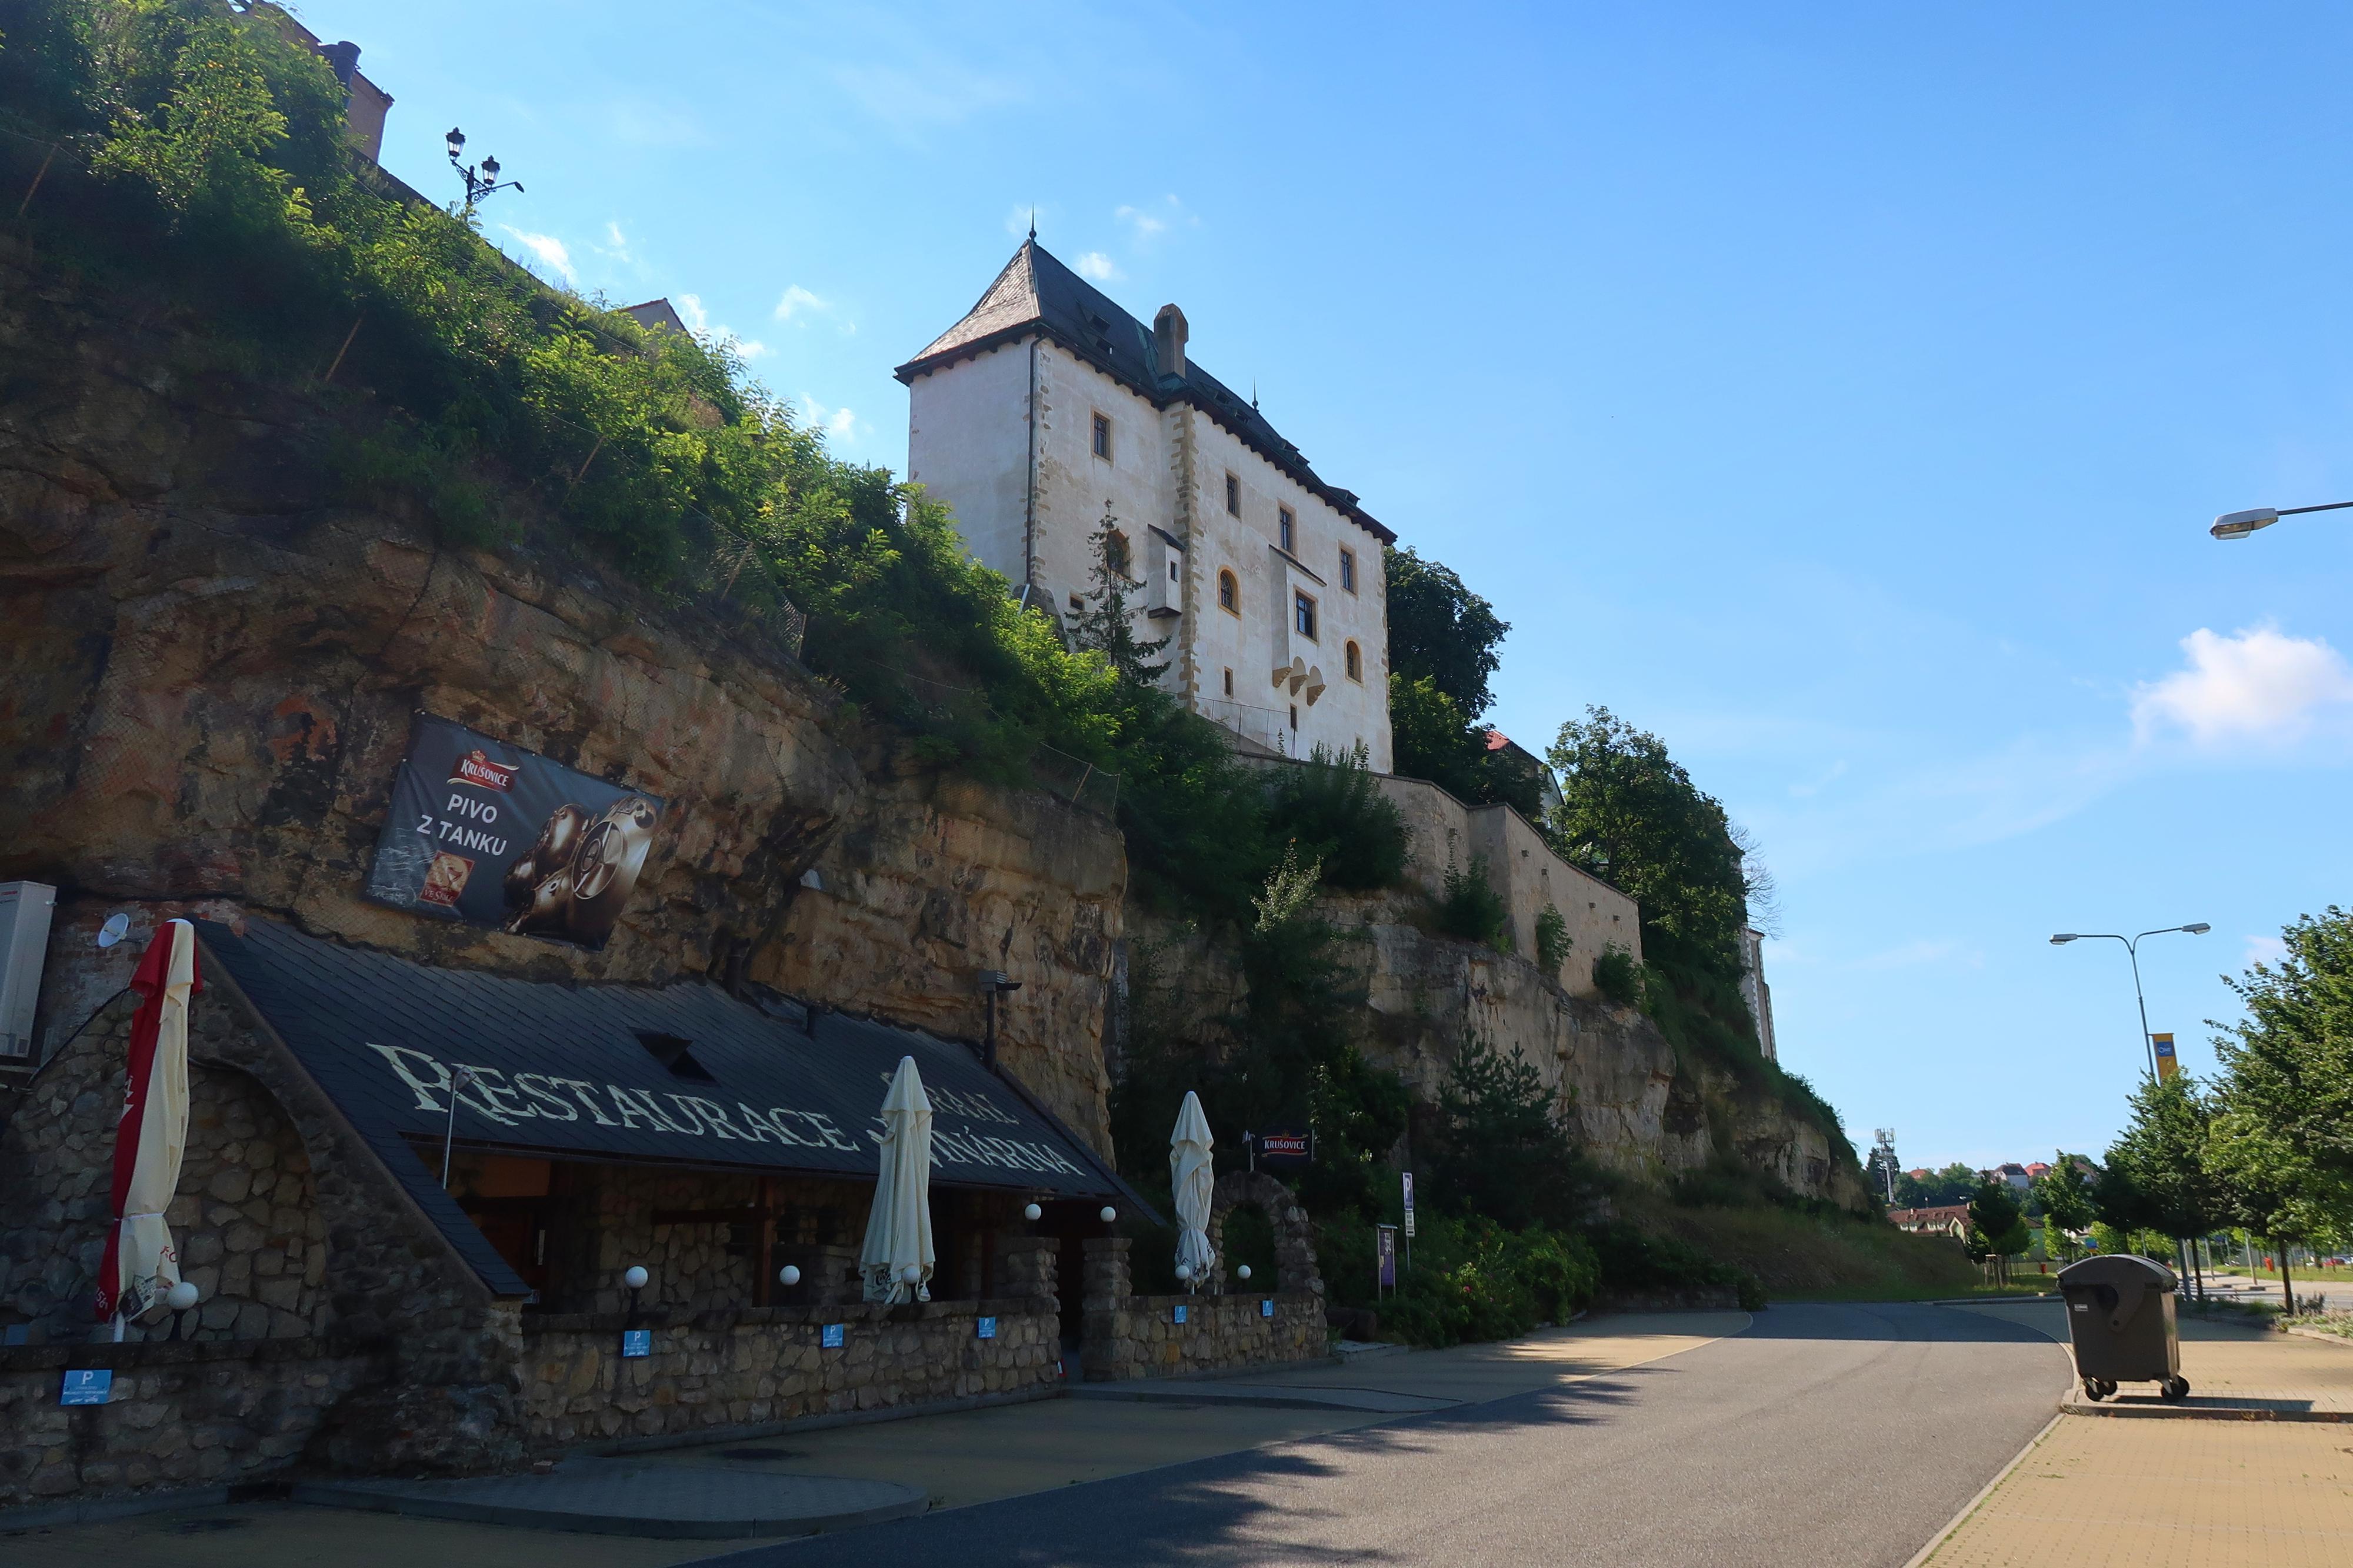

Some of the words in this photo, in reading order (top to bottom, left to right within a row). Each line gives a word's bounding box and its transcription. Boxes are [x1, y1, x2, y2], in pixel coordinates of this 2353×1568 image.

[461, 759, 509, 786] KRUŠOVICE
[447, 793, 498, 823] PIVO
[416, 814, 433, 835] Z
[438, 820, 507, 856] TANKU
[365, 1042, 861, 1152] RESTAURACE
[1264, 1139, 1305, 1150] KRUŠOVICE
[1405, 1177, 1411, 1199] P
[635, 1332, 641, 1342] P
[830, 1326, 836, 1335] P
[82, 1371, 94, 1384] P
